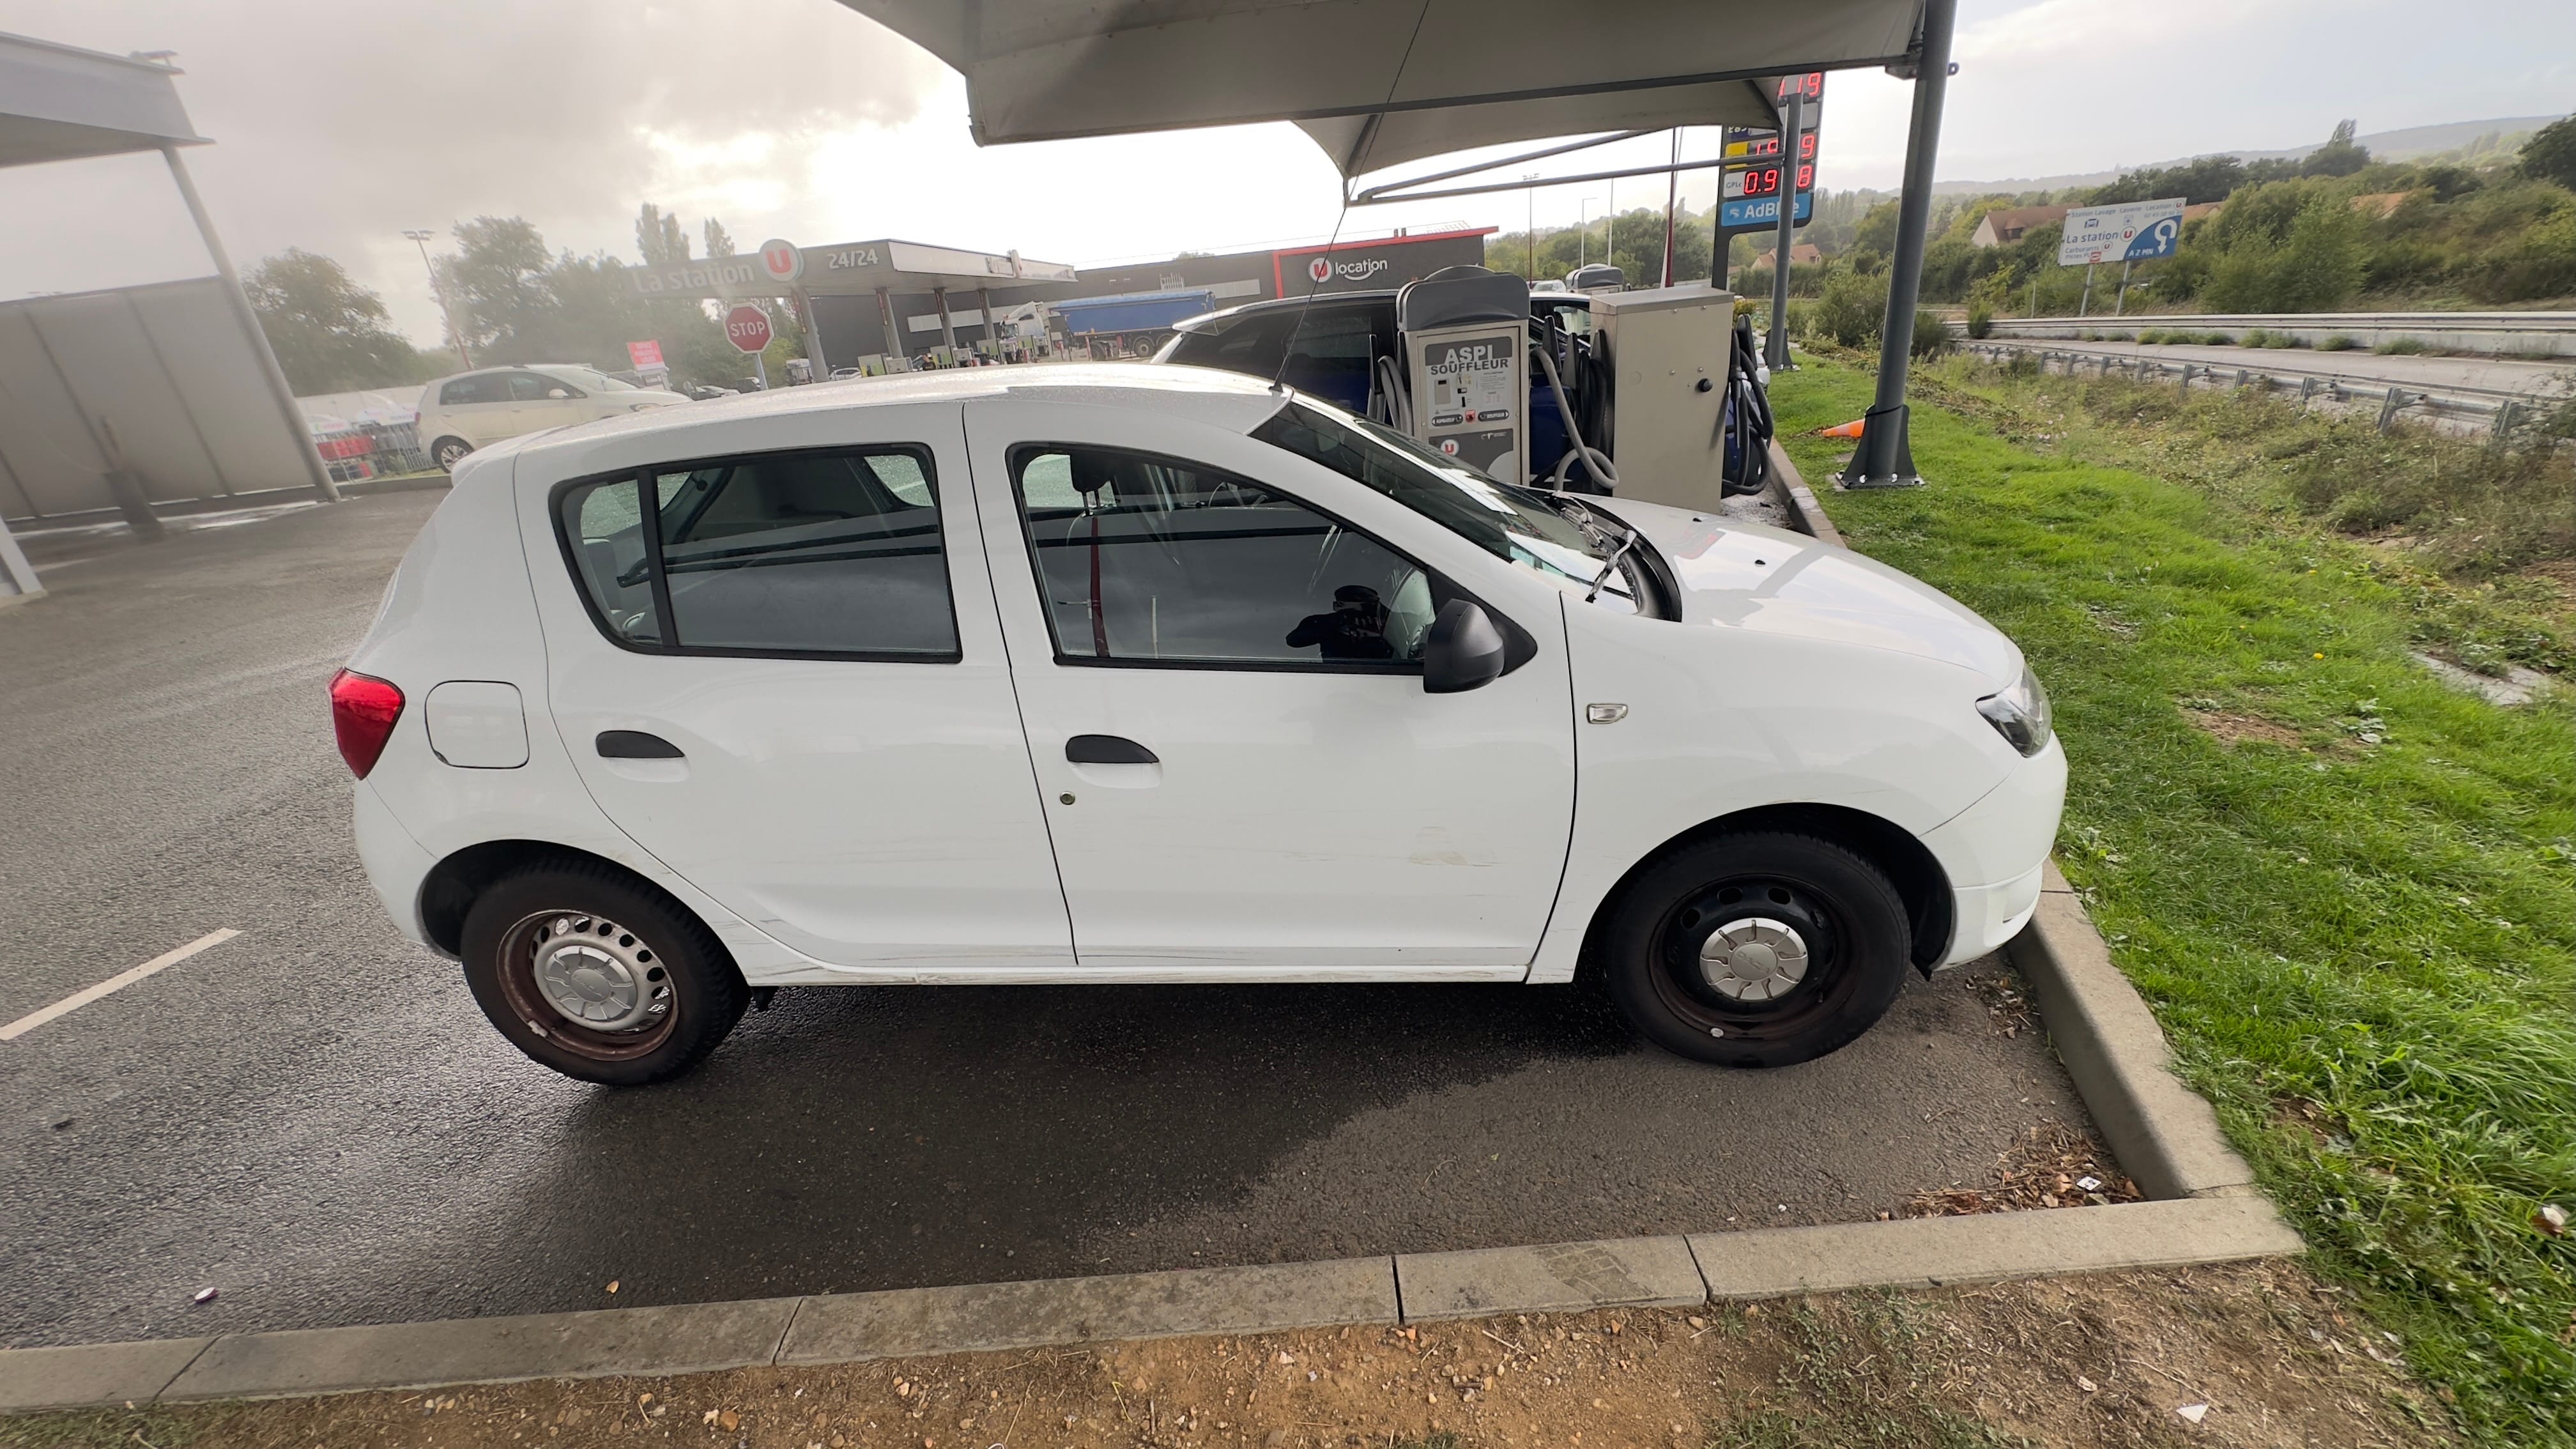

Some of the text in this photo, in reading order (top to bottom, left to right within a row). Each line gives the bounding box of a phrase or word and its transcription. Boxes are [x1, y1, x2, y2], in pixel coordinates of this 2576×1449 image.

[1744, 202, 1800, 218] AdBle
[2066, 230, 2133, 243] La station U
[631, 249, 879, 293] La station U 24/24
[1314, 258, 1388, 277] U location
[730, 321, 765, 337] STOP
[1444, 344, 1493, 365] ASPI
[1430, 359, 1508, 375] SOUFFLEUR
[1445, 443, 1454, 453] U
